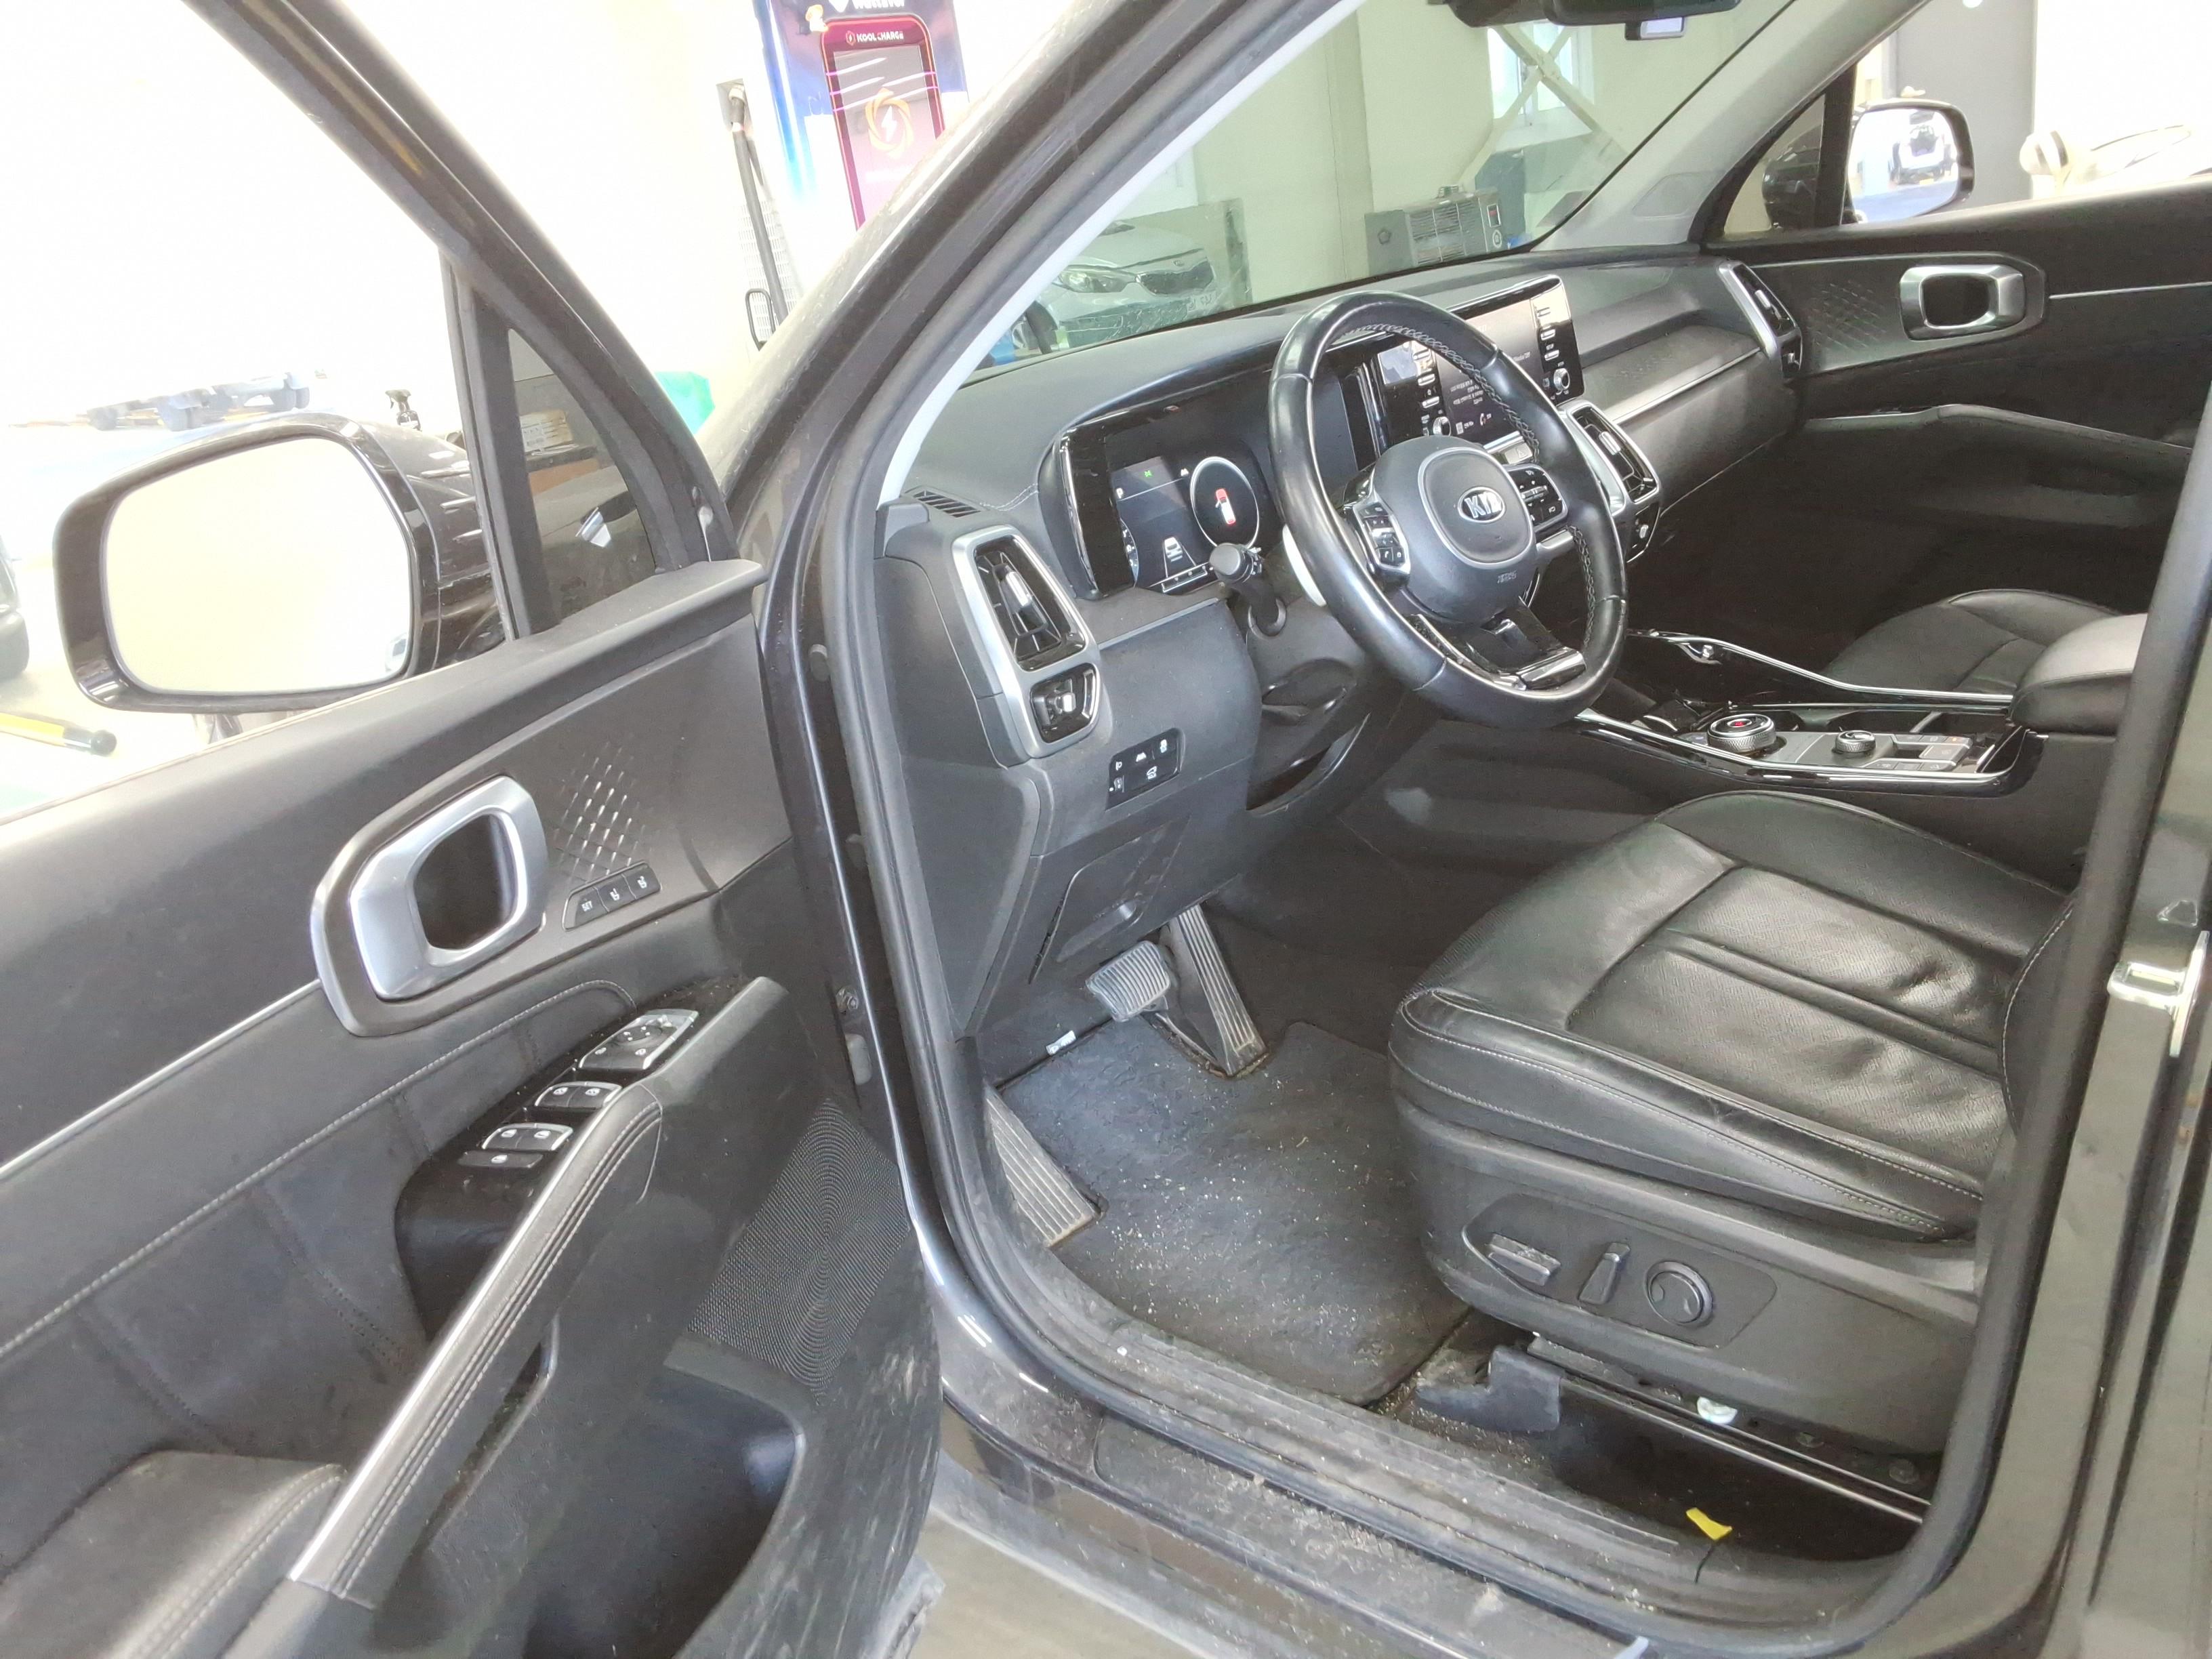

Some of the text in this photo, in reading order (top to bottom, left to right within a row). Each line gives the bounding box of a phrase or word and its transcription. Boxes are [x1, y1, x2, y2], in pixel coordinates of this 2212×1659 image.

[856, 30, 904, 43] KOOL CHARGE
[1464, 491, 1502, 519] KIA
